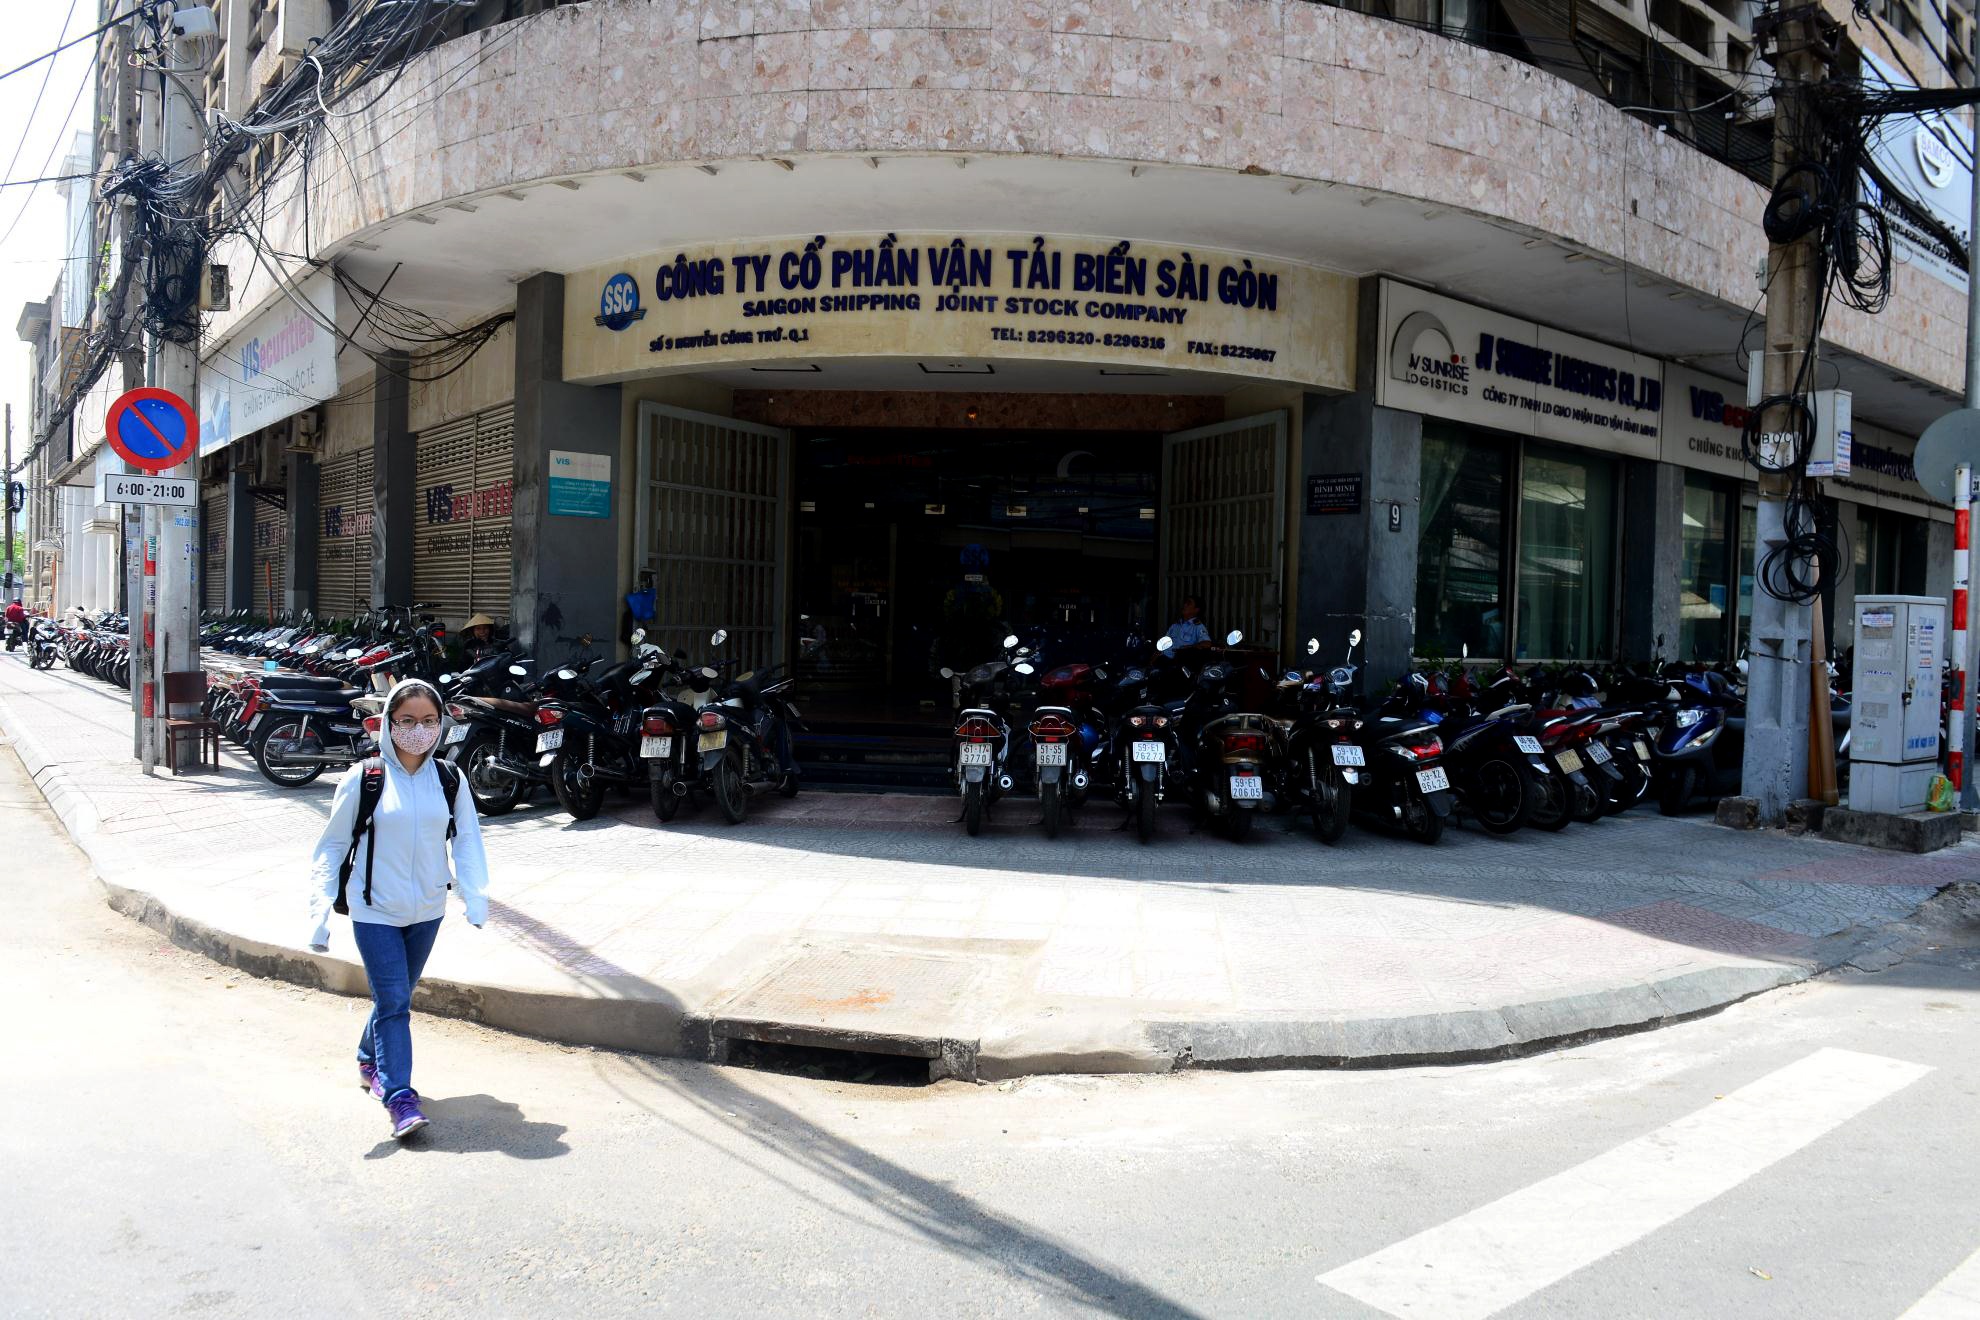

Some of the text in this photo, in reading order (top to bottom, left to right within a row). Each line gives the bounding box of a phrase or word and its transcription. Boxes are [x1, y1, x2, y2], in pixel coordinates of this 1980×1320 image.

[656, 232, 1278, 311] CÔNG TY CỔ PHẦN VẬN TẢI BIỂN SÀI GÒN
[603, 280, 634, 317] SSC
[742, 294, 1188, 325] SAIGON SHIPPING JOINT STOCK COMPANY
[665, 337, 674, 350] 9
[991, 327, 1022, 342] TEL:
[1187, 340, 1219, 355] FAX:
[1422, 356, 1470, 382] SUNRISE
[1405, 371, 1468, 396] LOGISTICS
[1482, 385, 1507, 404] CÔNG
[1509, 393, 1519, 407] TY
[1520, 397, 1541, 412] TNHH
[1542, 402, 1552, 414] LD
[1553, 404, 1571, 418] GIAO
[1688, 437, 1723, 457] CHỨNG
[1768, 454, 1776, 466] 3
[117, 483, 144, 496] 6:00
[153, 485, 185, 498] 21:00
[1391, 505, 1400, 524] 9
[964, 754, 987, 763] 3770
[1041, 745, 1062, 754] 51-S5
[1041, 755, 1062, 764] 9676
